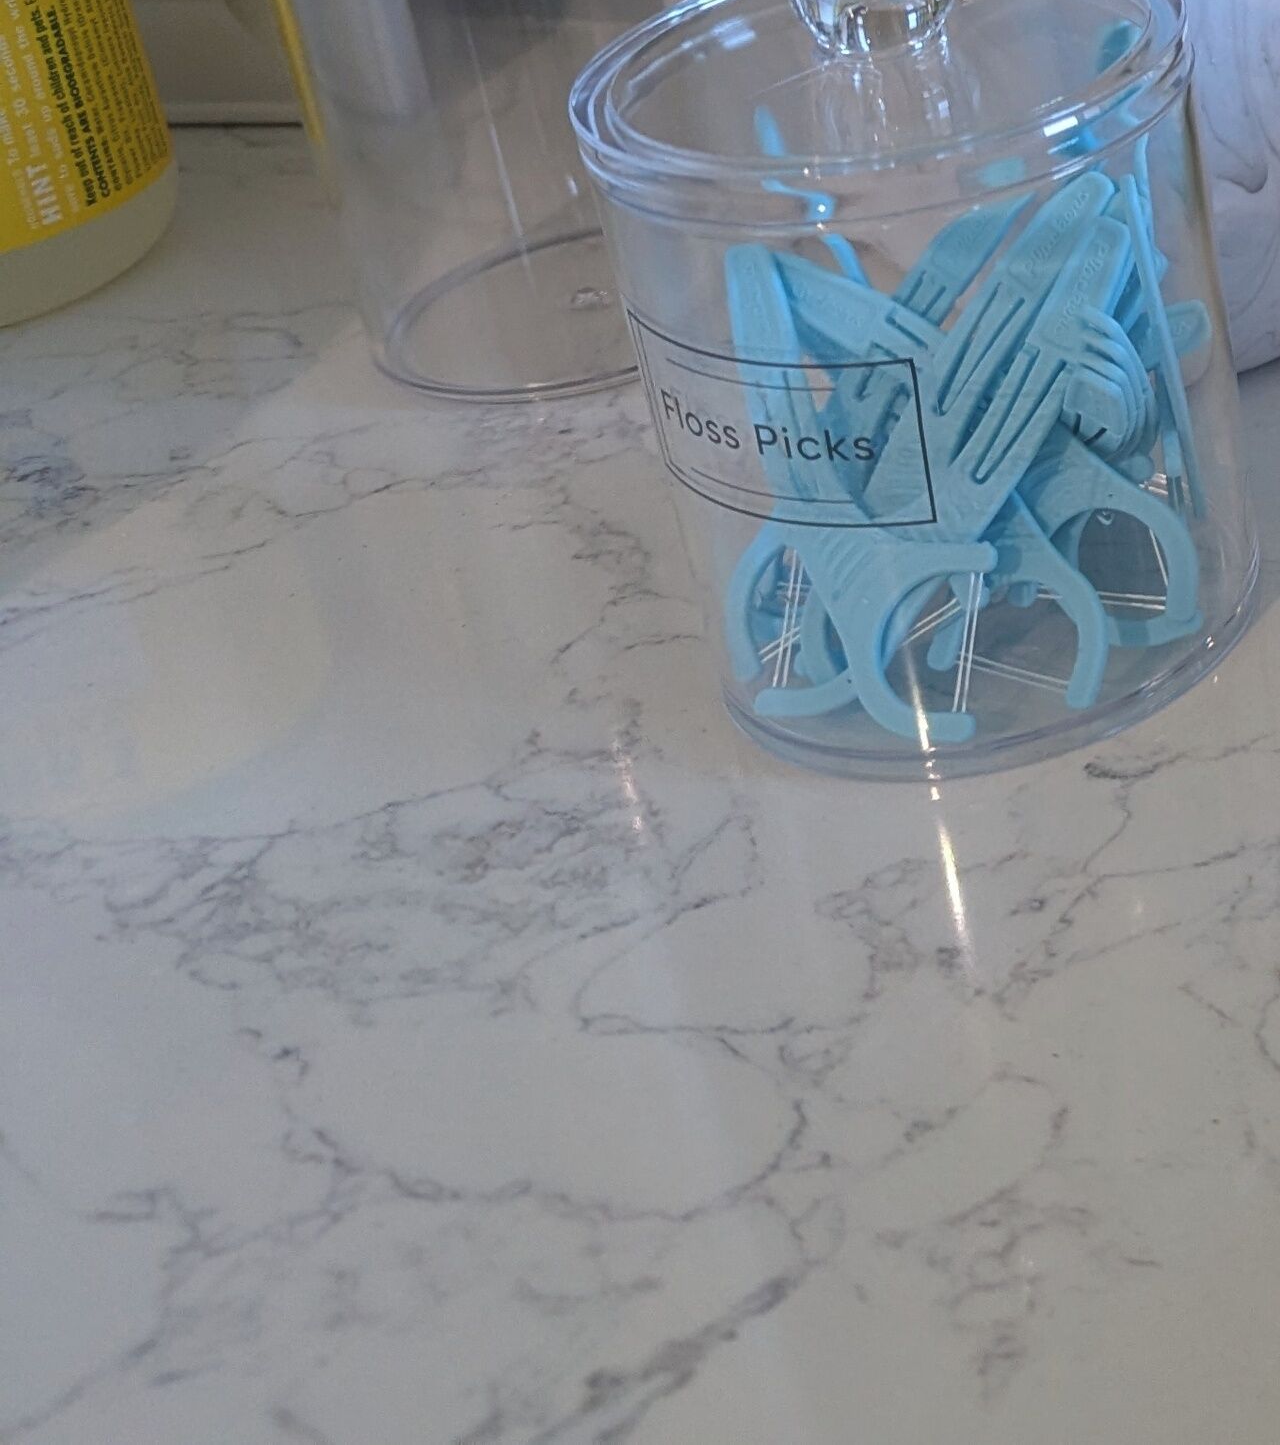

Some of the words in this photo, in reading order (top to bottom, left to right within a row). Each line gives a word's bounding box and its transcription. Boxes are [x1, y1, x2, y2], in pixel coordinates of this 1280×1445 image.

[27, 4, 48, 34] pets.
[35, 34, 52, 56] and
[41, 55, 66, 101] children
[54, 100, 70, 114] of
[75, 109, 92, 134] ARE
[58, 113, 80, 147] reach
[68, 146, 83, 160] of
[84, 135, 111, 198] CONTENTS
[73, 158, 89, 179] out
[25, 160, 63, 225] HINT
[77, 177, 99, 207] Keep
[659, 388, 741, 451] Floss
[753, 423, 875, 462] Picks
